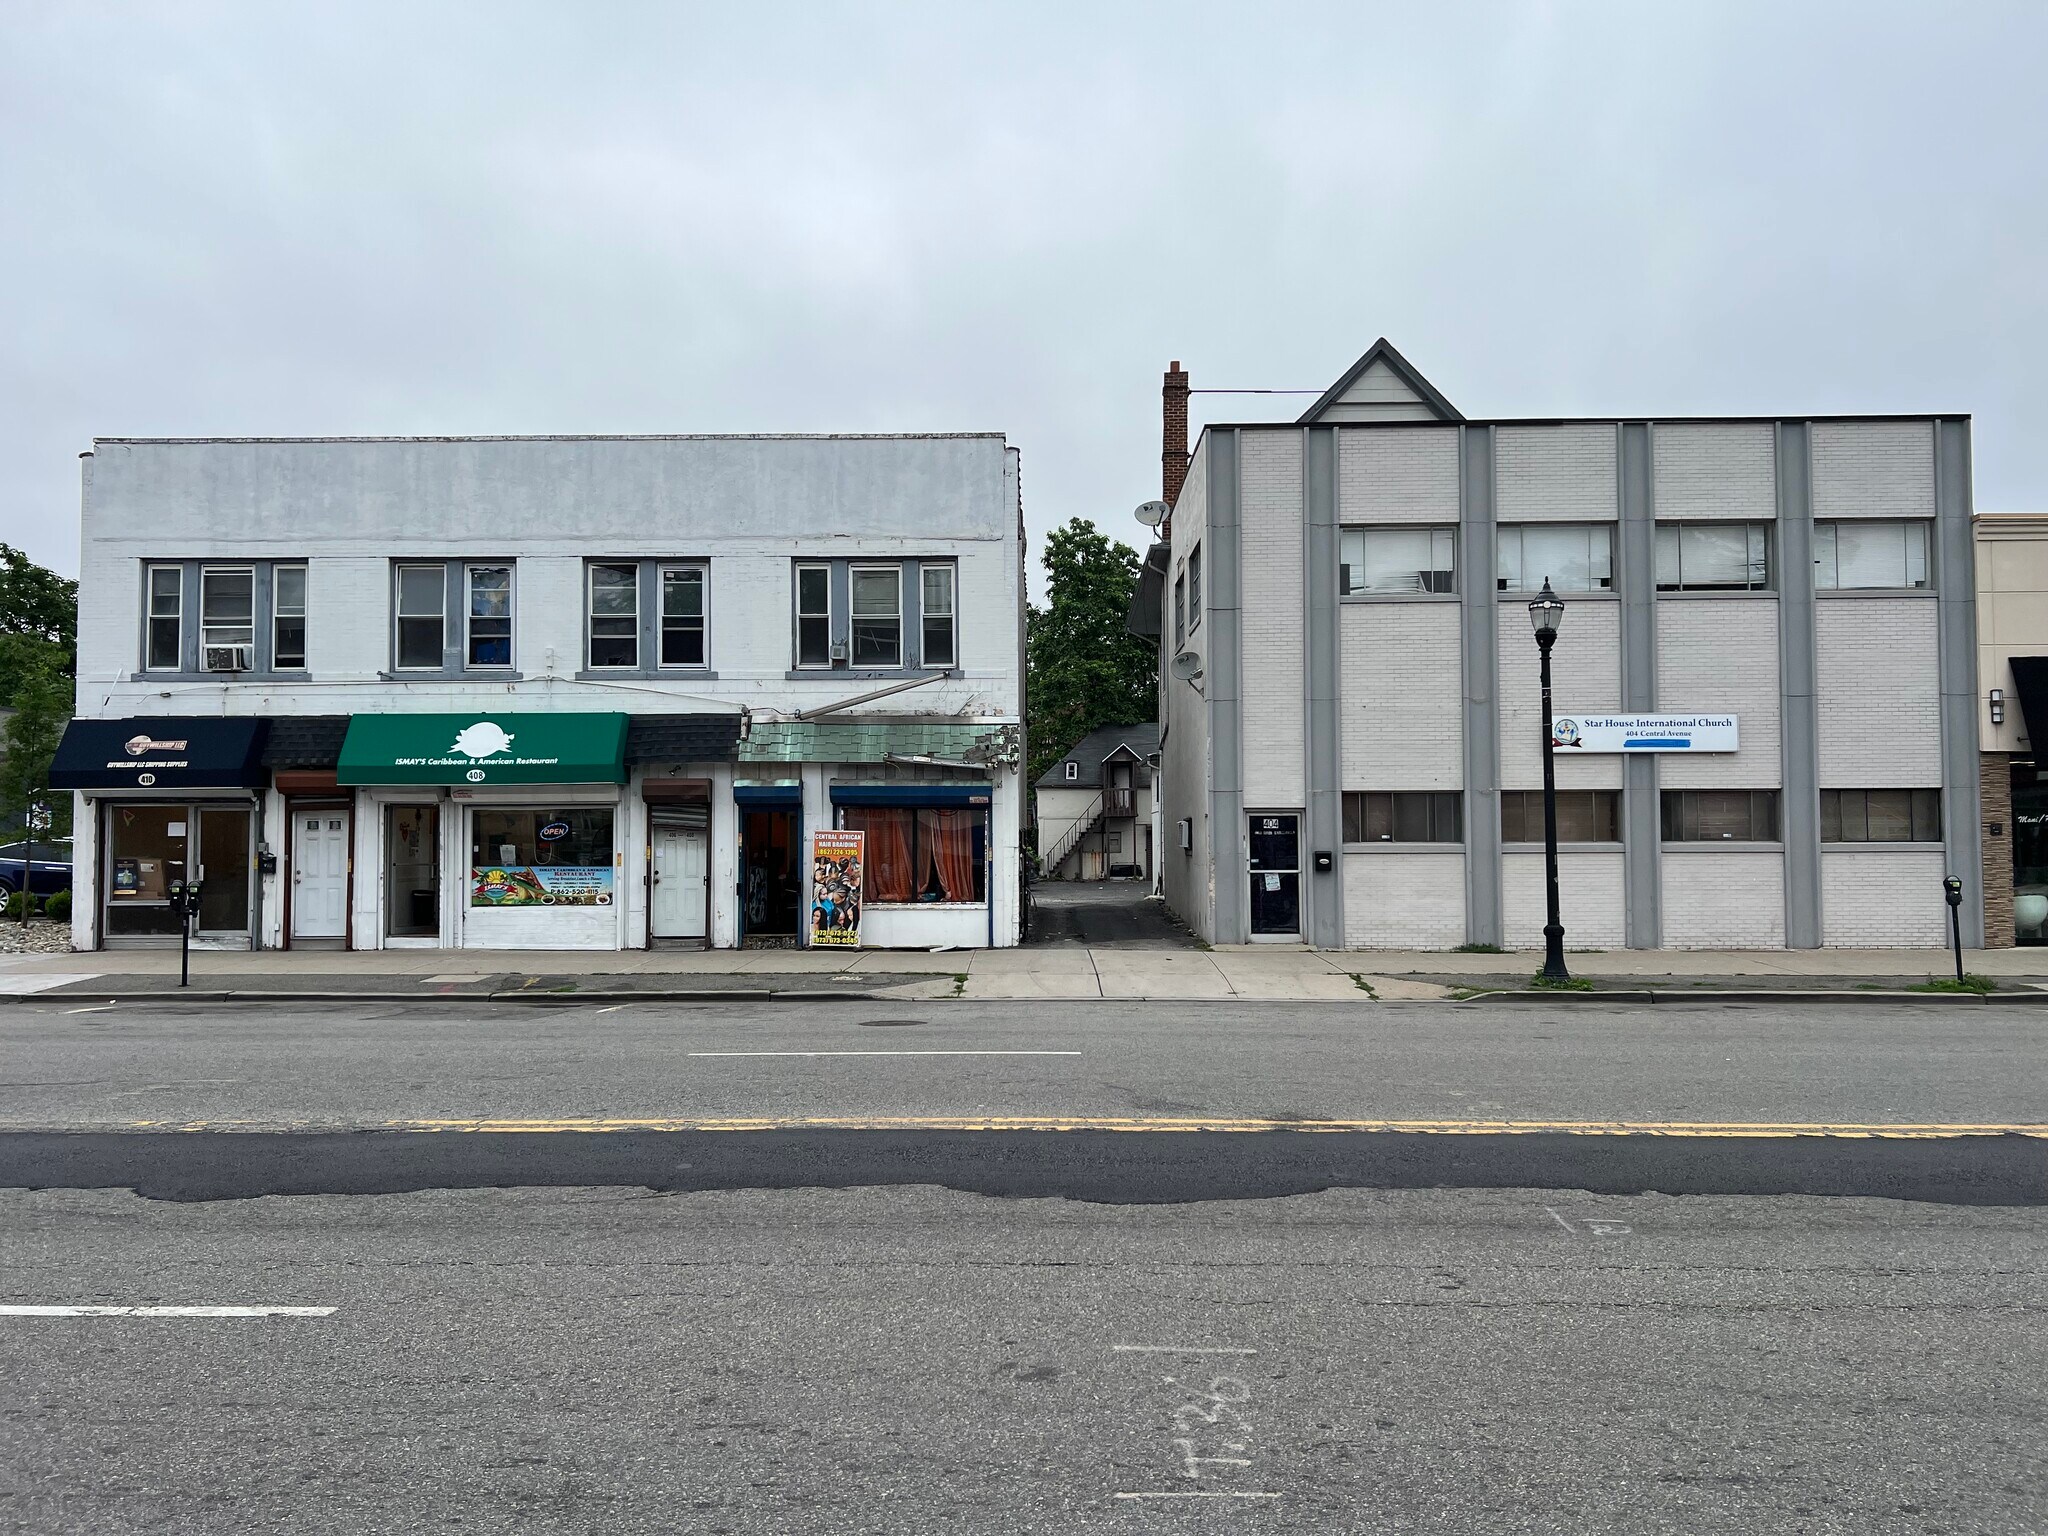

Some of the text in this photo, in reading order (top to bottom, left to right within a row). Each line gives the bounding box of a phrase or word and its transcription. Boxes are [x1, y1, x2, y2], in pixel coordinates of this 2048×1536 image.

[1584, 718, 1732, 727] Star House International Church
[427, 757, 467, 765] Caribbean
[515, 757, 559, 765] Restaurant
[141, 775, 153, 783] 410
[468, 771, 484, 780] 408
[1263, 818, 1279, 829] 404
